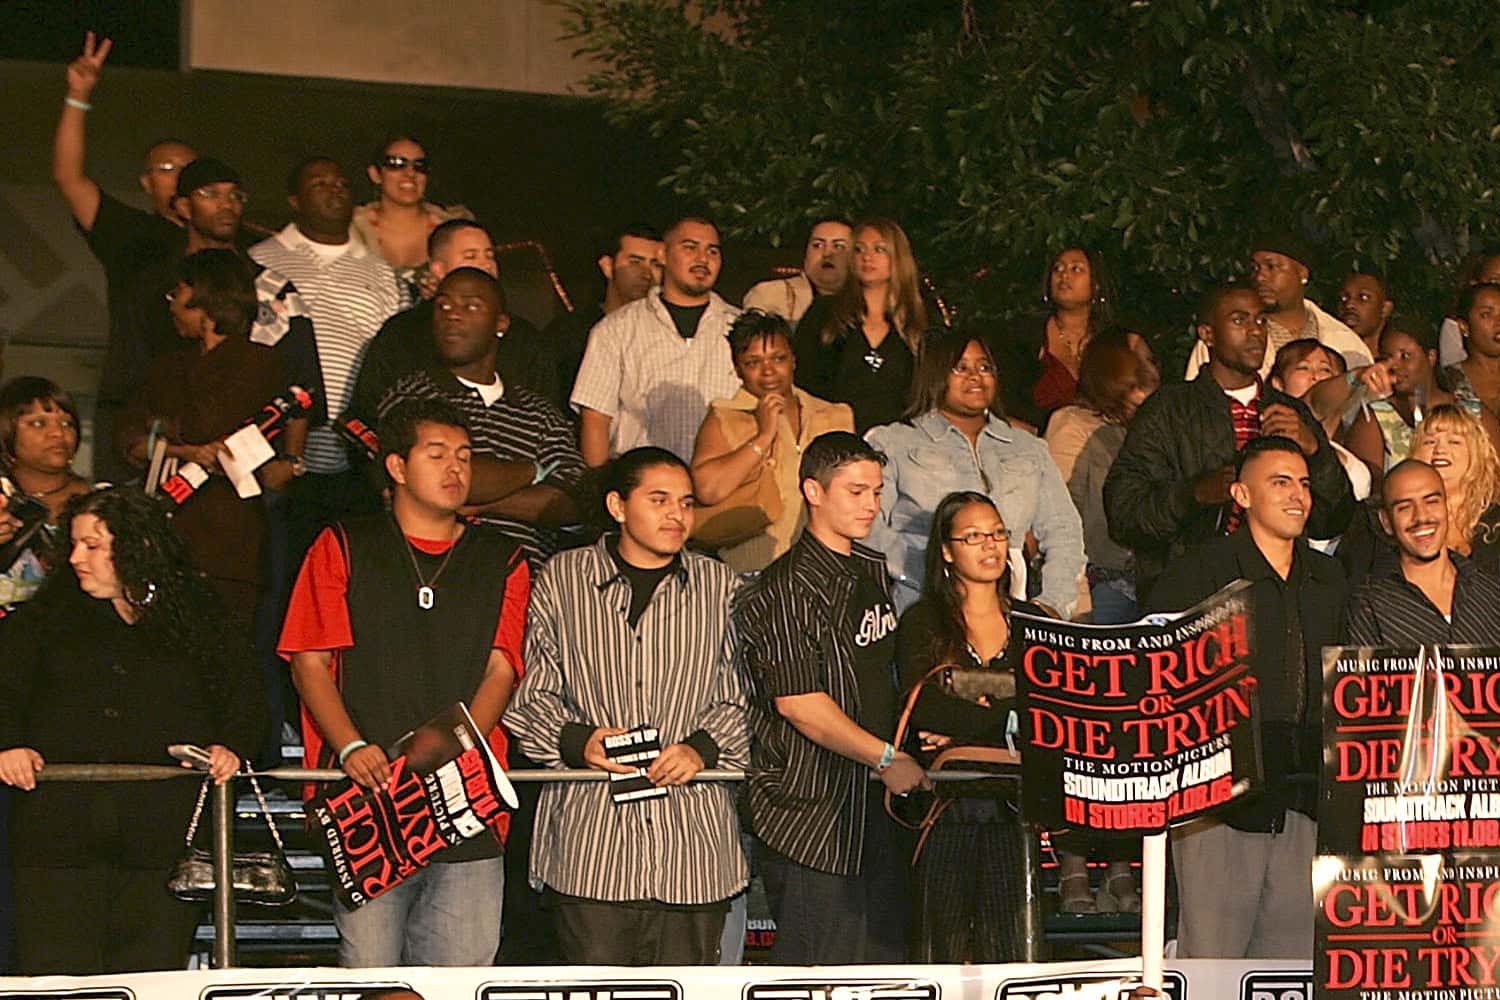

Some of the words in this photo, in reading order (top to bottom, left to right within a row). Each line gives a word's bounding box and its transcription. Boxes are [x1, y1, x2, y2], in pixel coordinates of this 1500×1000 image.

[1023, 646, 1136, 697] GET
[1145, 614, 1249, 695] RICH
[1024, 627, 1075, 648] MUSIC
[1082, 638, 1131, 651] FROM
[1137, 633, 1173, 649] AND
[1337, 659, 1379, 673] MUSIC
[1384, 658, 1420, 672] FROM
[1427, 657, 1455, 671] AND
[1138, 695, 1176, 715] OR
[1334, 673, 1416, 719] GET
[1029, 707, 1117, 759] DIE
[1122, 675, 1257, 759] TRYIN'
[1063, 772, 1179, 802] SOUNDTRACK
[1181, 748, 1232, 788] ALBUM
[1064, 757, 1096, 773] THE
[1103, 758, 1174, 775] MOTION
[1177, 734, 1231, 765] PICTURE
[1336, 739, 1403, 781] DIE
[425, 773, 450, 831] PICTURE
[1366, 783, 1387, 795] THE
[1394, 780, 1458, 794] MOTION
[315, 808, 331, 825] BY
[388, 756, 447, 866] RYIN
[1065, 797, 1086, 825] IN
[1089, 801, 1168, 830] STORES
[1363, 795, 1467, 823] SOUNDTRACK
[326, 784, 394, 899] RICH
[1362, 825, 1378, 851] IN
[1382, 822, 1450, 849] STORES
[327, 828, 353, 889] INSPIRED
[1384, 868, 1423, 881] FROM
[1324, 883, 1425, 927] GET
[1432, 926, 1456, 944] OR
[1324, 948, 1412, 989] DIE
